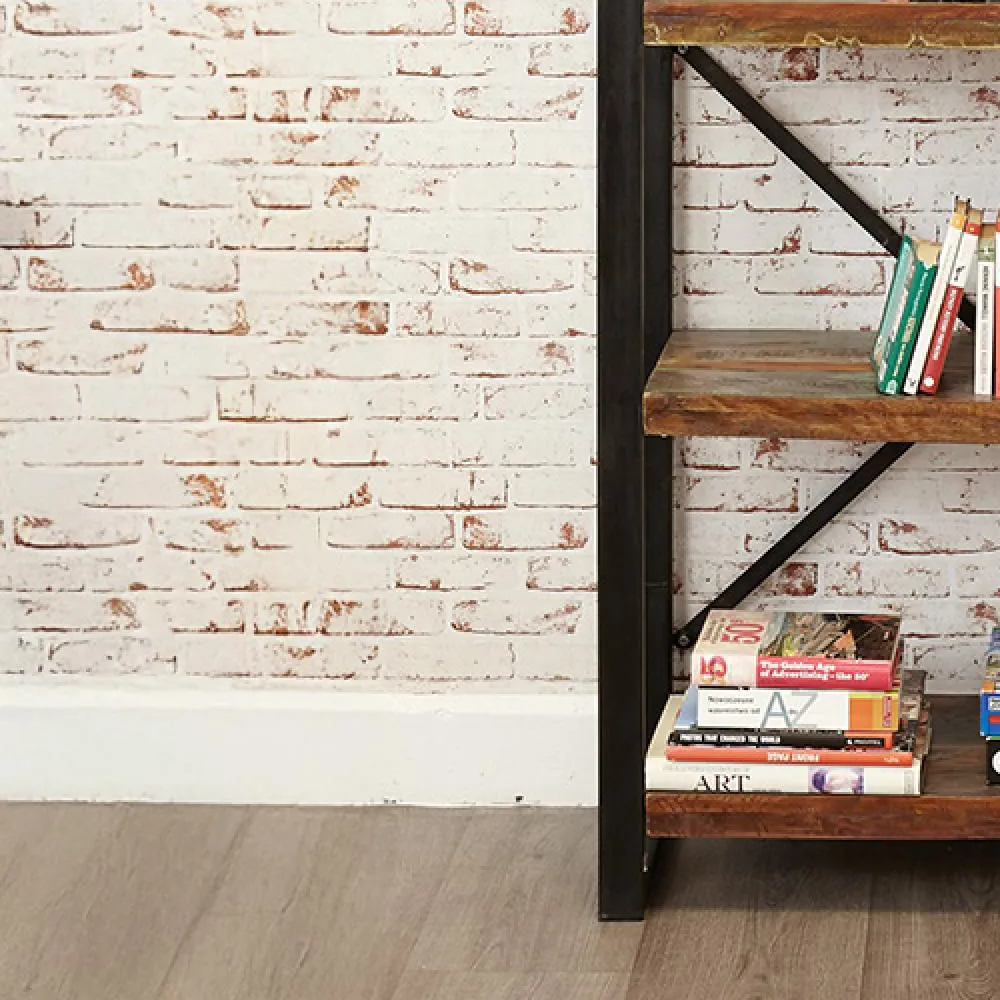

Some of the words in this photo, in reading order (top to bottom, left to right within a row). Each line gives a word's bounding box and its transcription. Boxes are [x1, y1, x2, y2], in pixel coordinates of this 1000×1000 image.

[759, 661, 777, 670] The
[781, 661, 815, 670] Golden
[817, 663, 836, 672] Age
[759, 670, 771, 679] of
[772, 671, 829, 681] Advertising
[836, 672, 853, 681] the
[761, 691, 794, 729] A
[790, 691, 819, 729] Z
[704, 734, 718, 742] THAT
[720, 735, 746, 743] CHANGED
[761, 736, 781, 744] WORLD
[693, 774, 751, 792] ART
